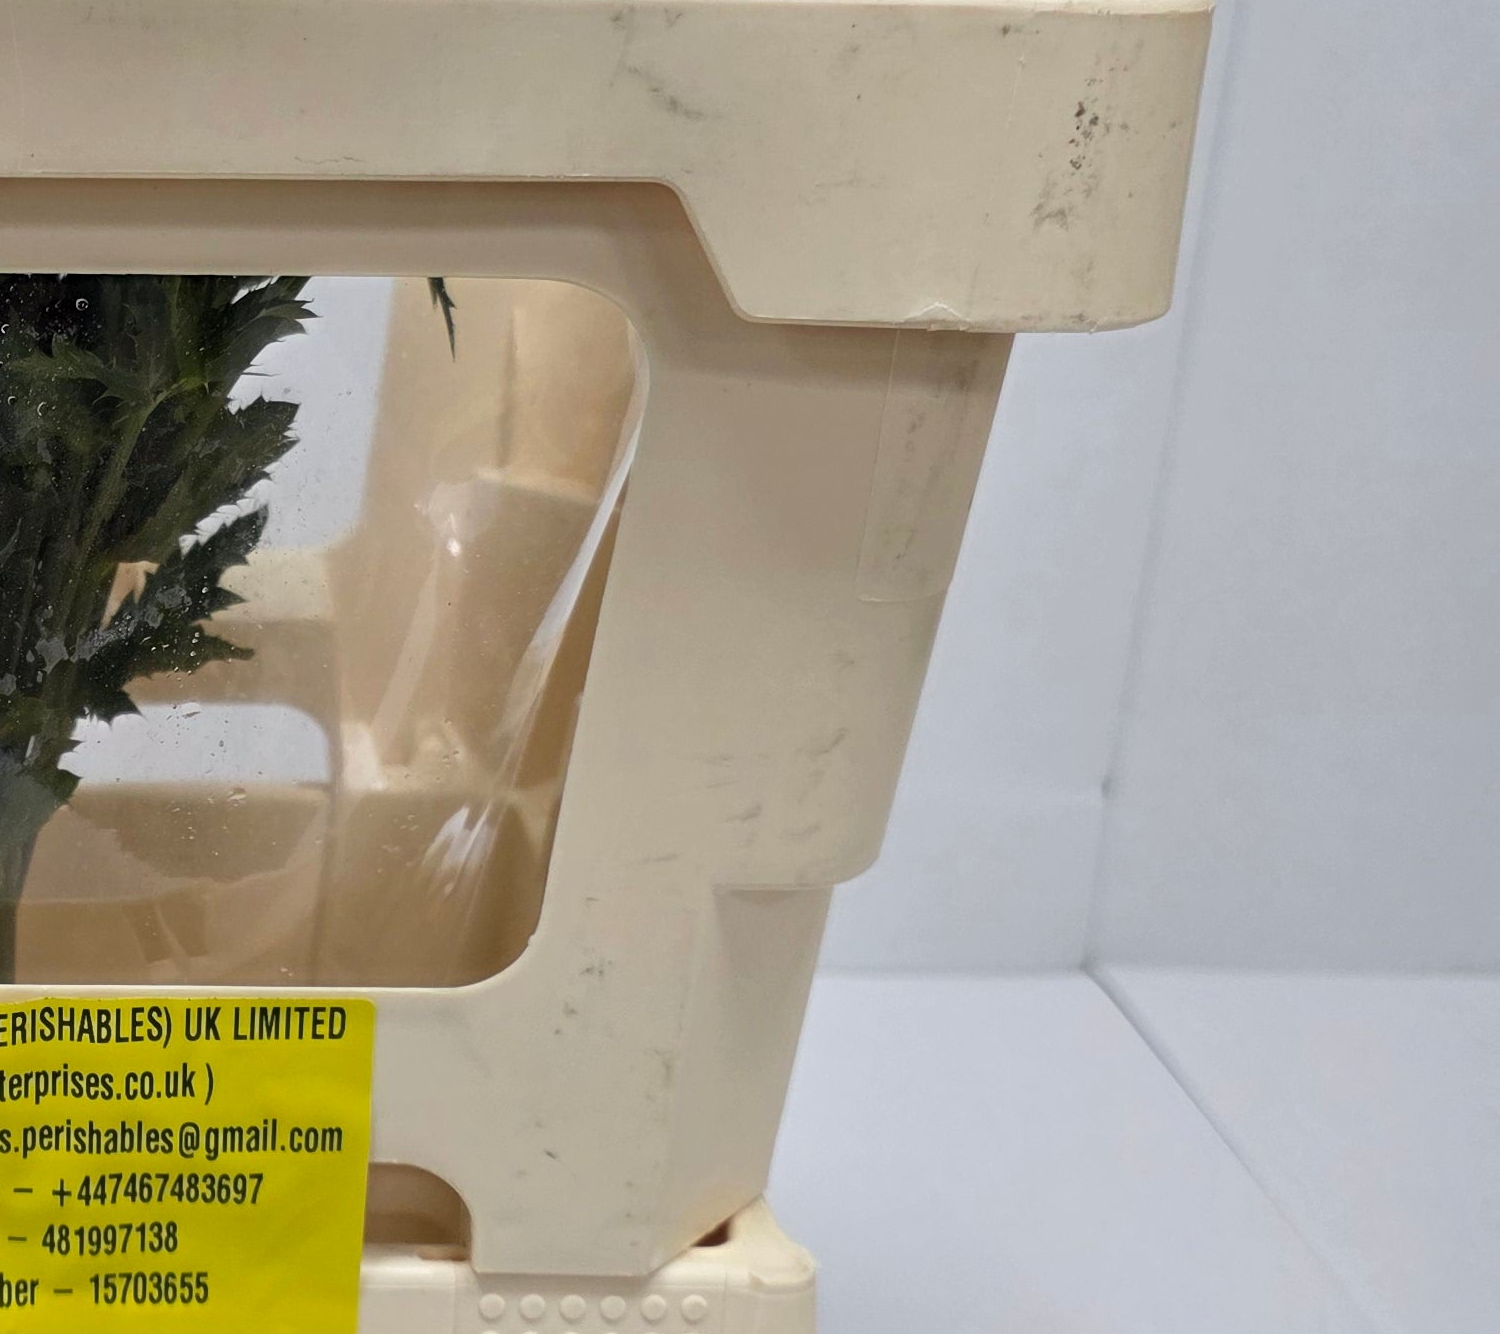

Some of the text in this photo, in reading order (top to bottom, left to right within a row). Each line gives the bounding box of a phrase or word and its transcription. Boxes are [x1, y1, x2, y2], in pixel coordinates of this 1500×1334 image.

[185, 1007, 221, 1041] UK
[234, 1007, 346, 1040] LIMITED
[52, 1173, 263, 1207] +447467483697
[42, 1221, 178, 1256] 481997138
[89, 1272, 208, 1304] 15703655
